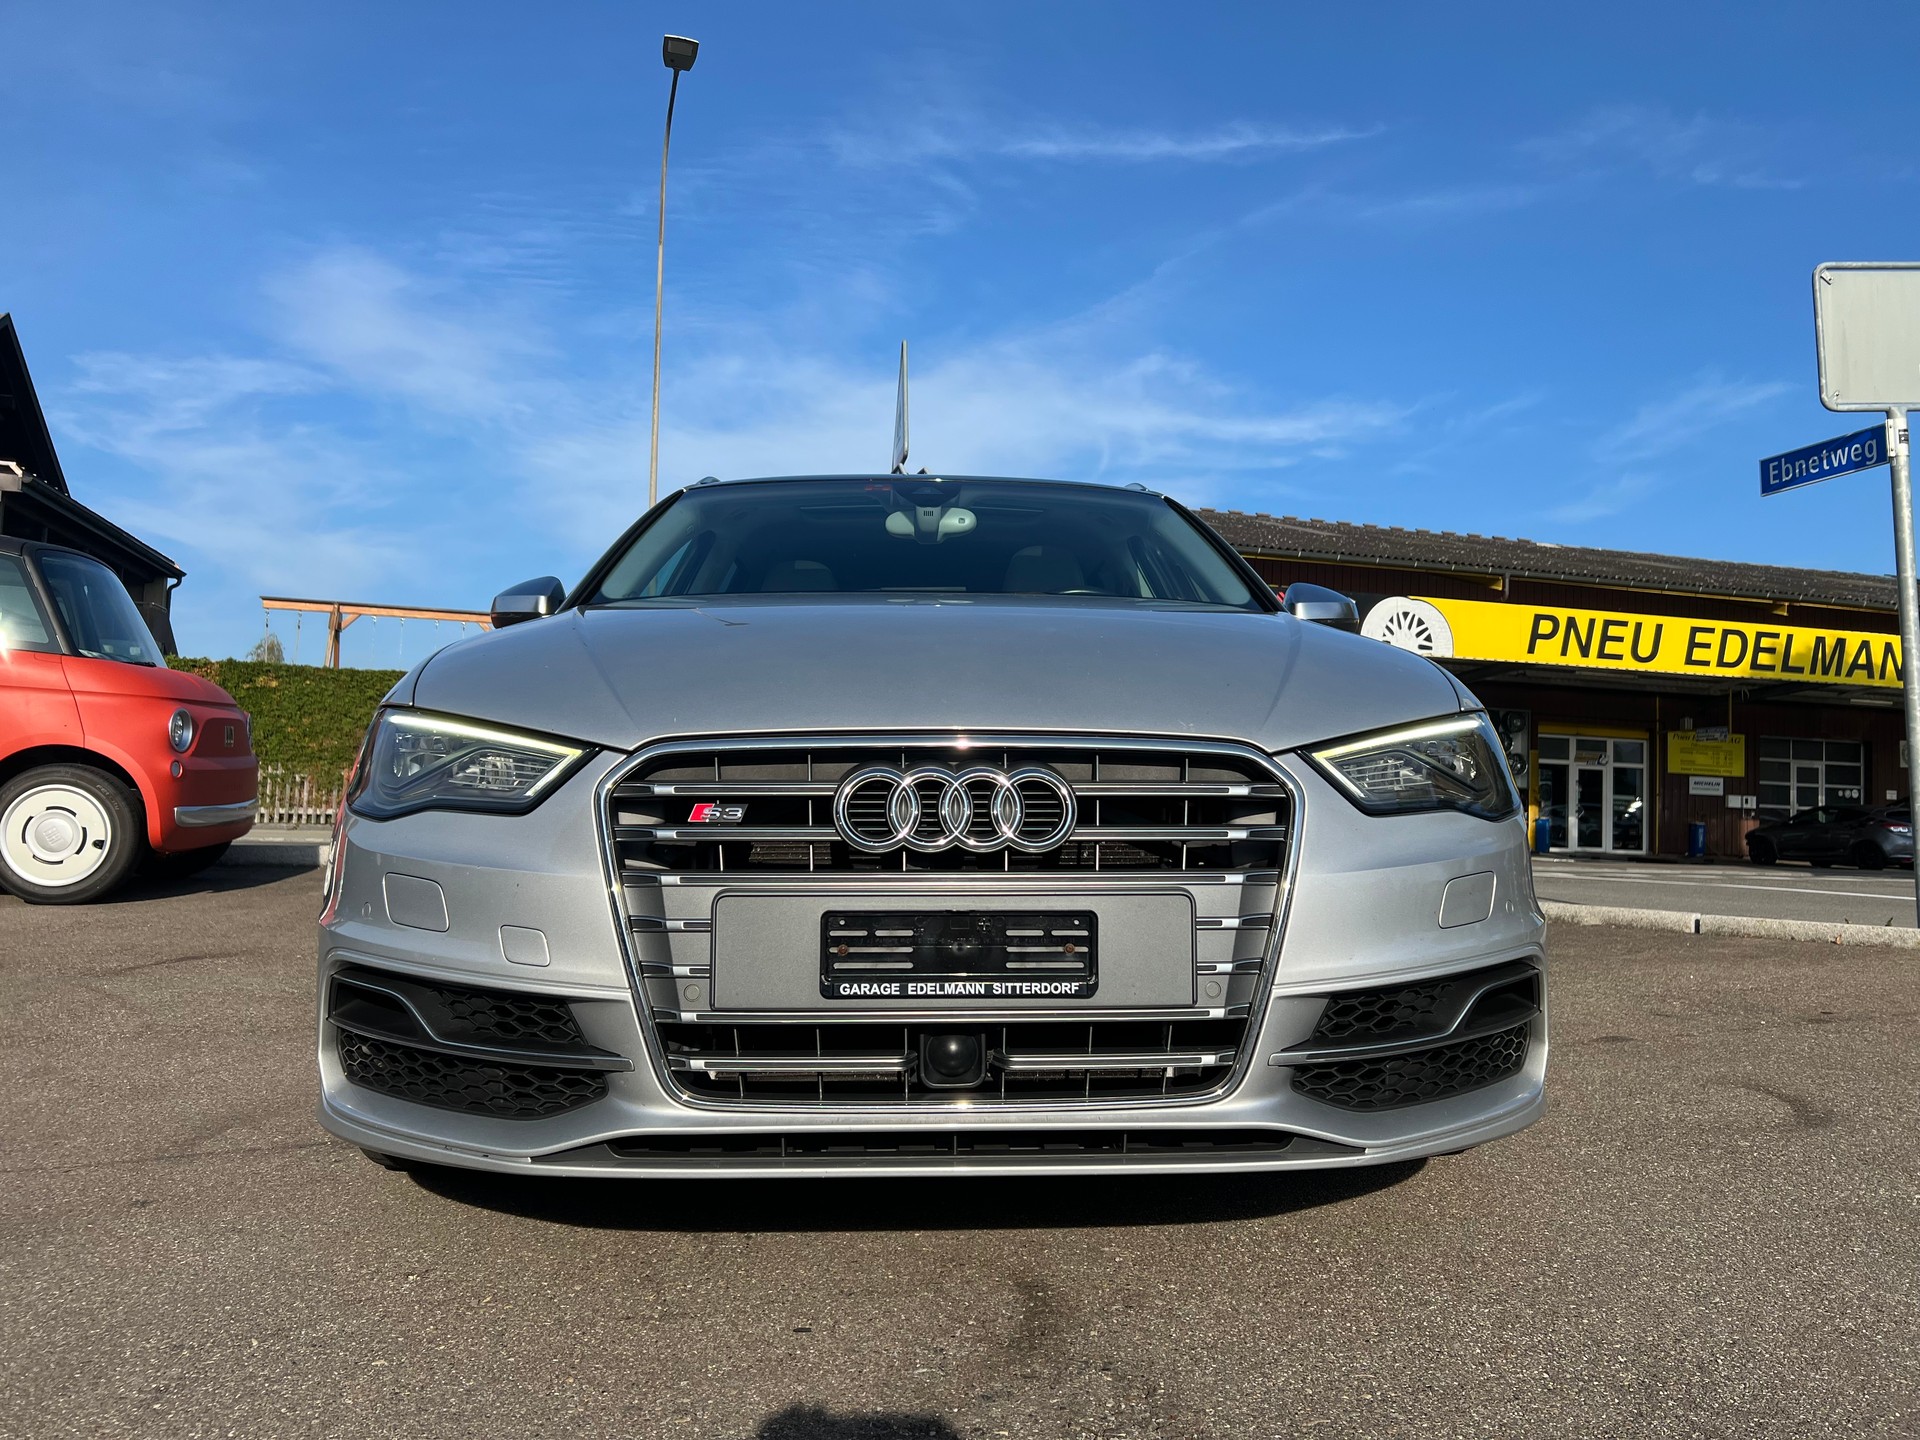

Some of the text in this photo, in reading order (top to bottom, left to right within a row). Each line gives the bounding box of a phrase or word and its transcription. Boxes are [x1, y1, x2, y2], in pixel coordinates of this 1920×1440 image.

[1769, 437, 1878, 485] Ebnetweg
[1526, 613, 1664, 663] PNEU
[700, 807, 743, 820] S3
[839, 982, 1080, 996] GARAGE EDELMANN SITTERDORF
